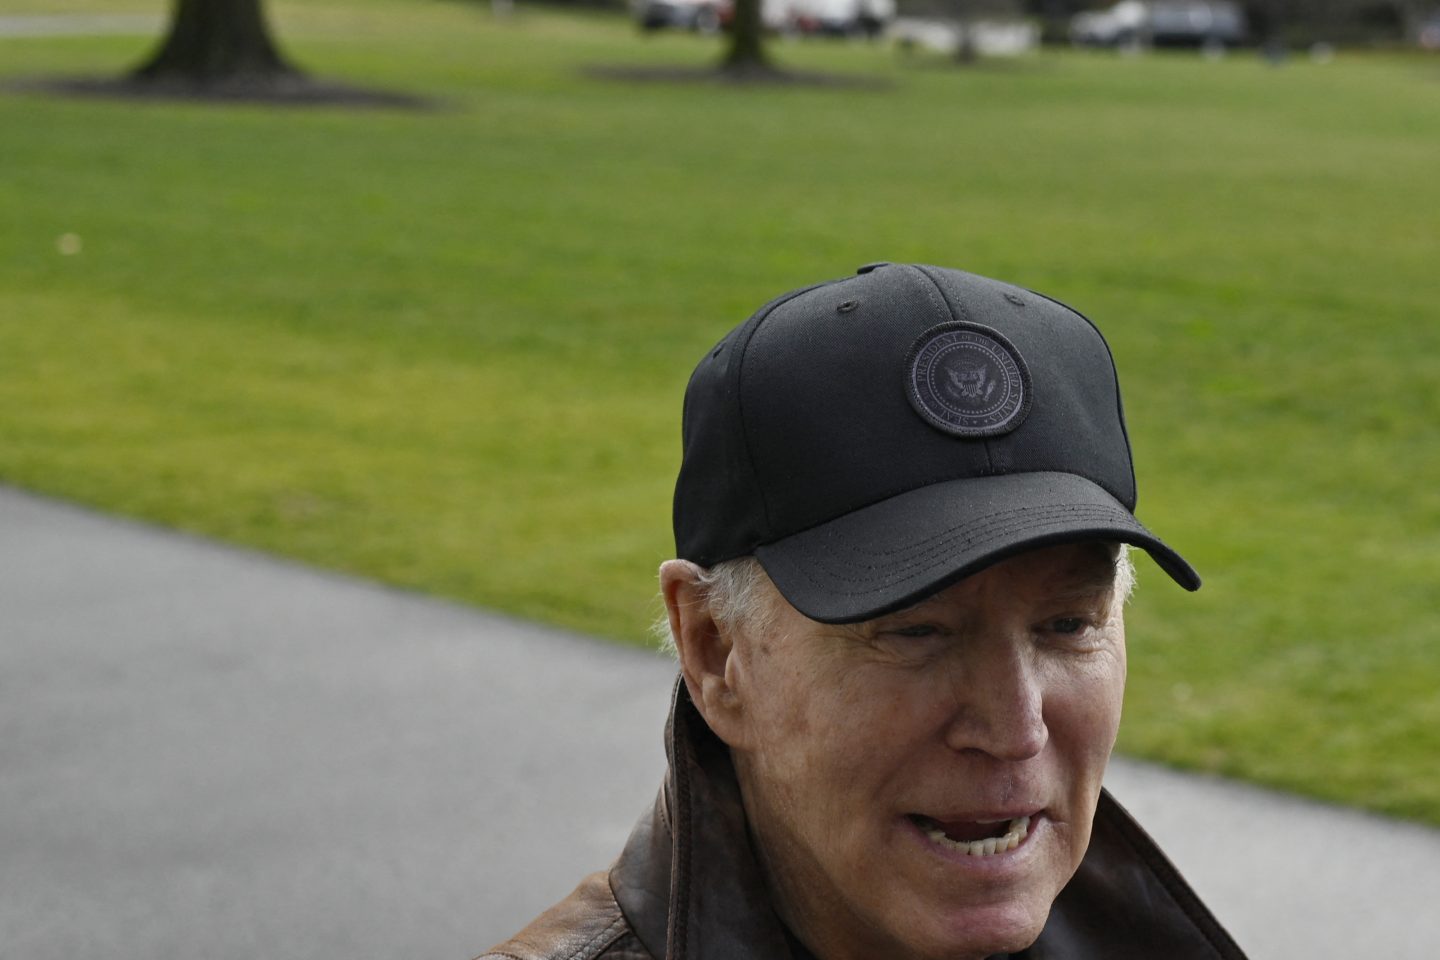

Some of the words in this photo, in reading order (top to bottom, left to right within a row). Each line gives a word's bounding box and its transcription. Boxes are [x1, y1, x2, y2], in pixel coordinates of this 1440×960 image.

[916, 334, 957, 382] PRESIDENT
[991, 344, 1019, 388] UNITED
[989, 392, 1019, 422] STATES
